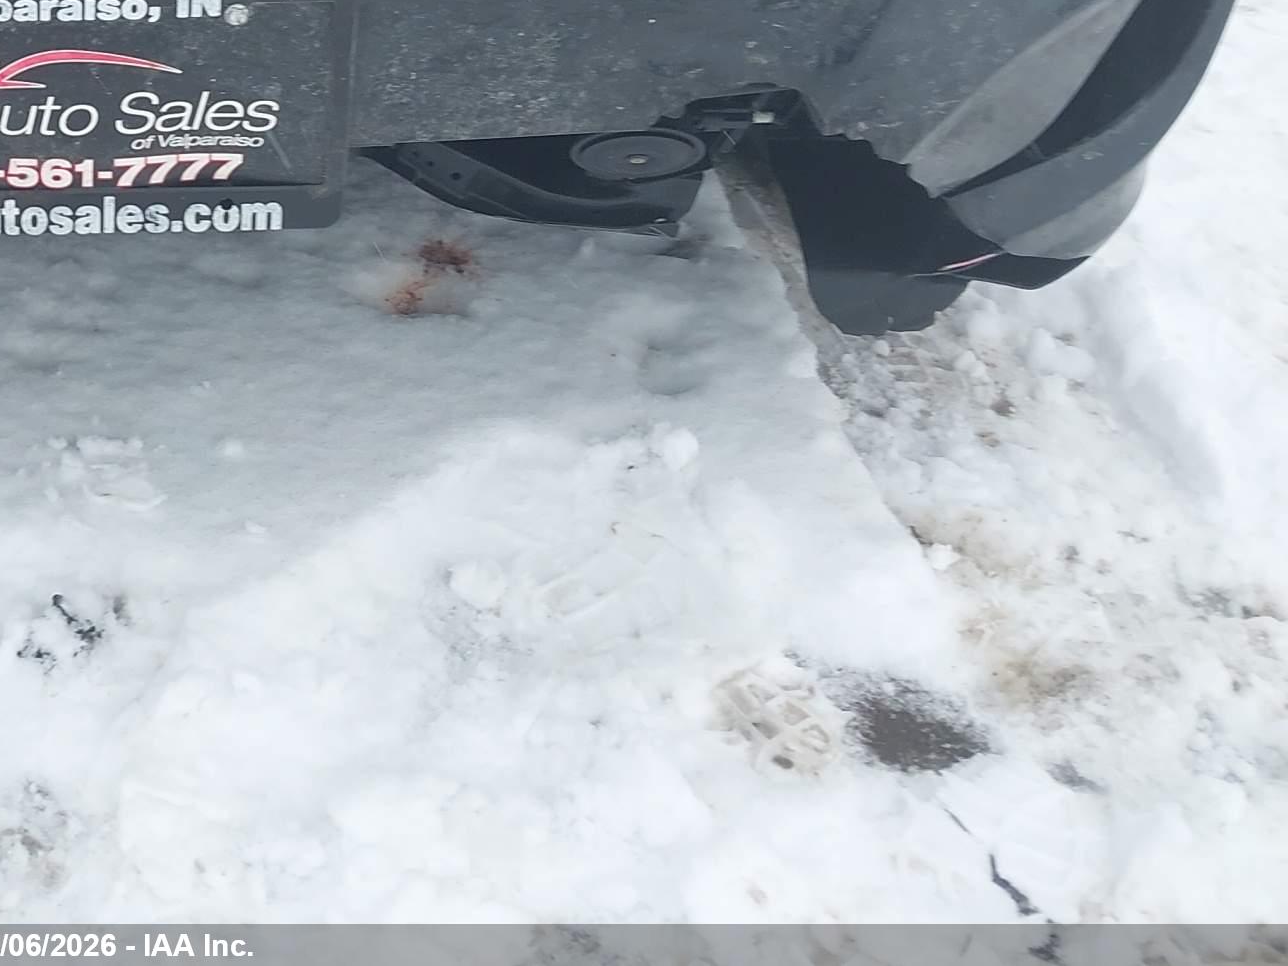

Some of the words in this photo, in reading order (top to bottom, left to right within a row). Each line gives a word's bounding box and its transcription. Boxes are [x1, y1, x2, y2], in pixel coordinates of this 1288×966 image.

[114, 91, 280, 135] Sales
[132, 135, 155, 150] of
[158, 134, 265, 151] Valparaiso
